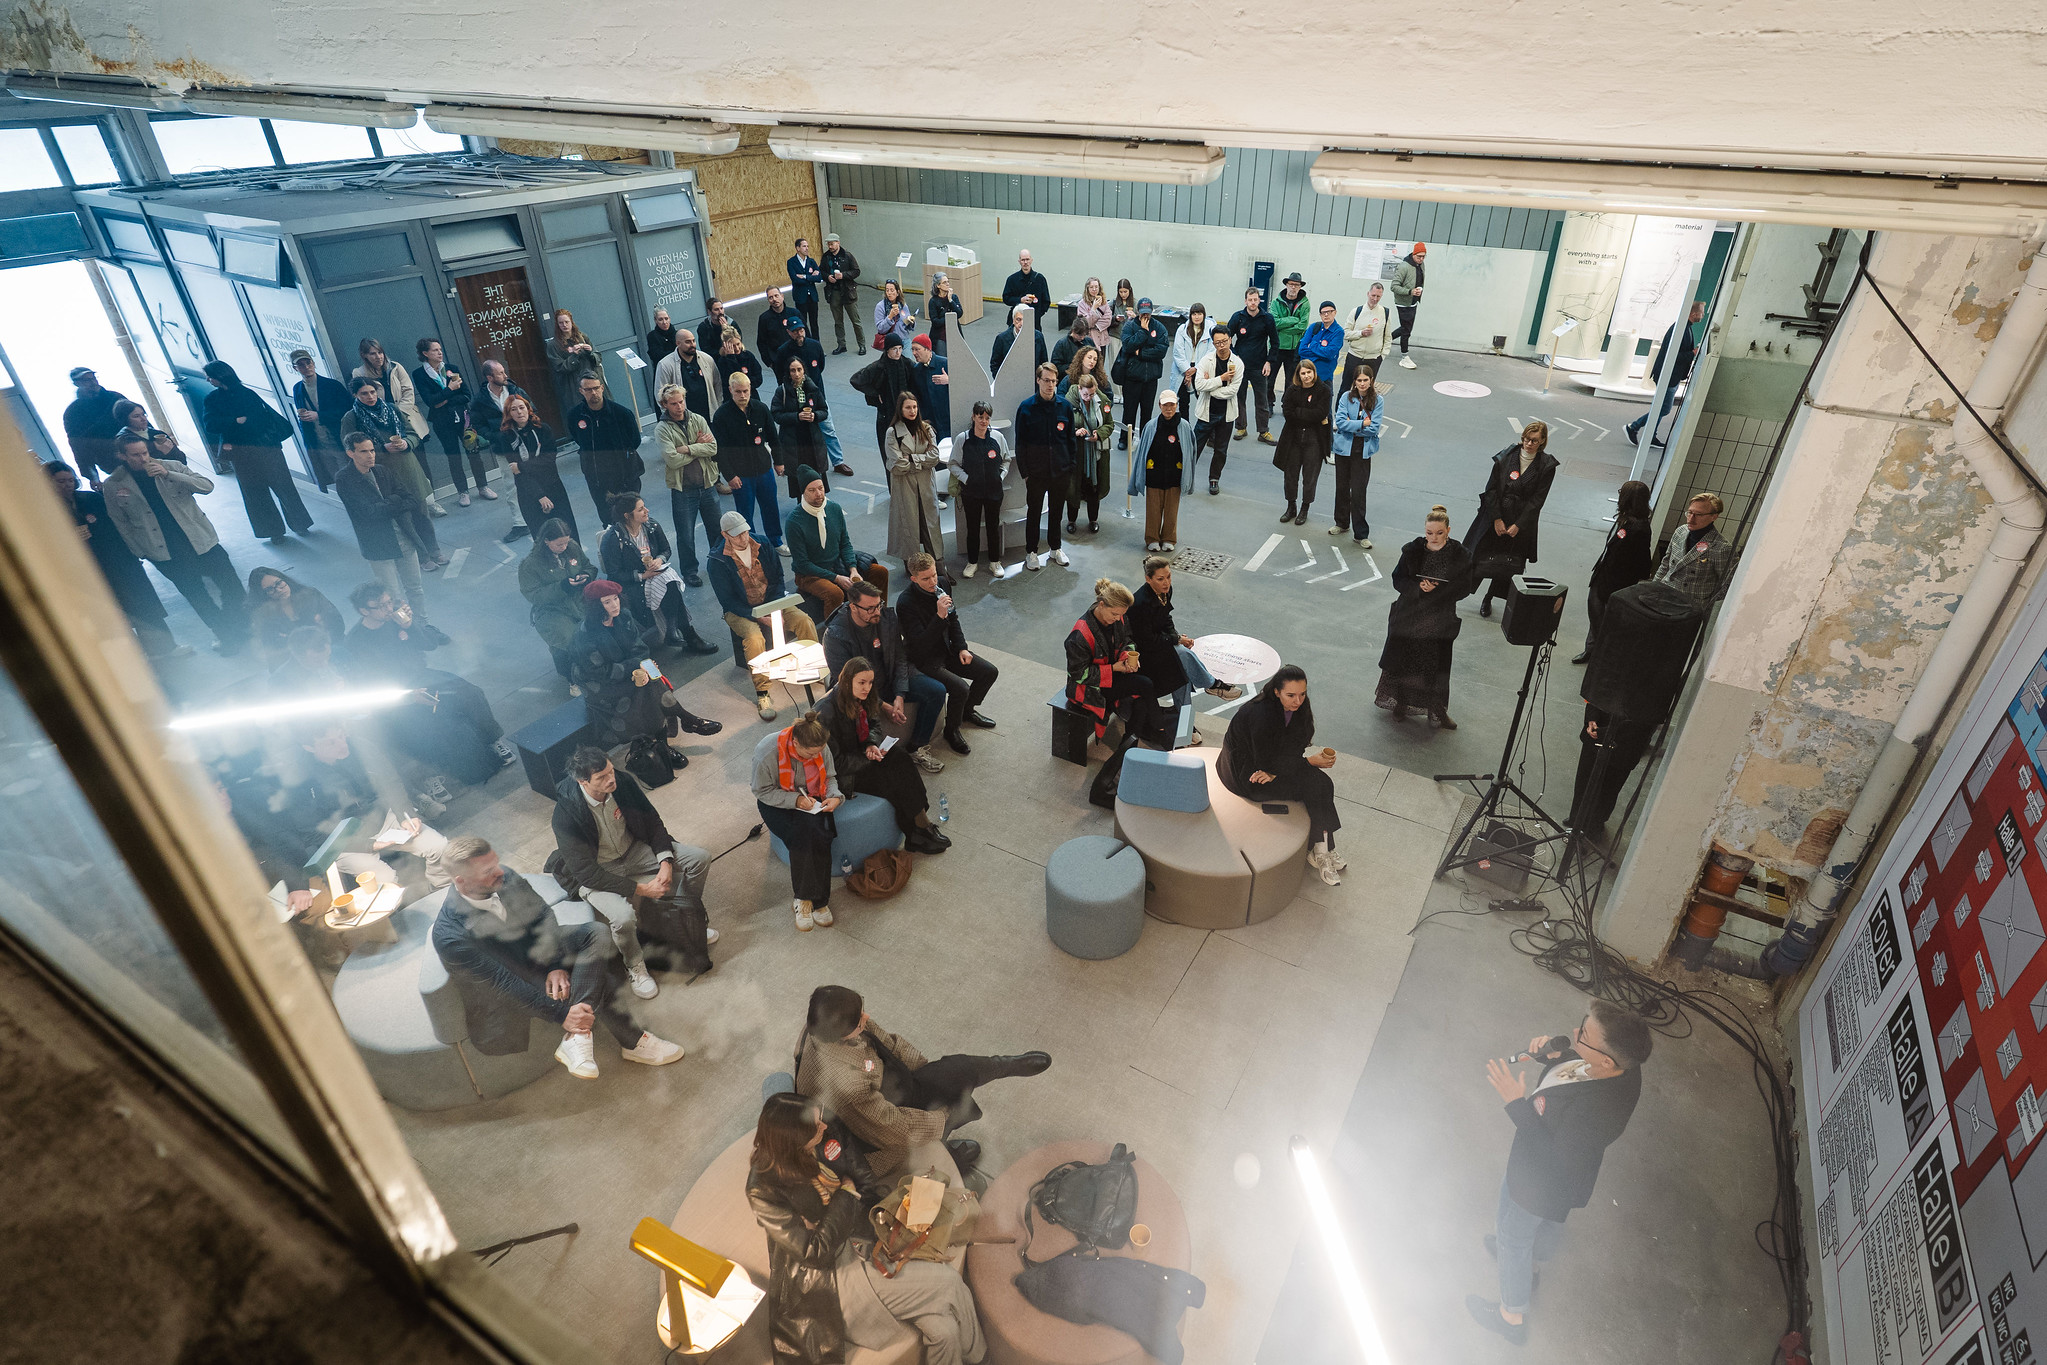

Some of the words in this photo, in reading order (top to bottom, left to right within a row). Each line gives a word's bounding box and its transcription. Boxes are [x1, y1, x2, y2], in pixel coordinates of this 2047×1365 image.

[647, 254, 672, 267] WHEN
[672, 250, 688, 262] HAS
[648, 270, 694, 288] CONNECTED
[656, 262, 683, 275] SOUND
[654, 285, 671, 296] YOU
[671, 280, 693, 292] WITH
[658, 291, 692, 306] OTHERS?
[263, 314, 286, 328] WHEN
[286, 318, 304, 332] HAS
[275, 328, 302, 342] SOUND
[1998, 814, 2015, 852] Halle
[2009, 847, 2022, 869] A
[1871, 896, 1894, 980] Foyer
[1859, 950, 1869, 1002] Immobilien
[1868, 952, 1878, 1000] Concepts
[1891, 1005, 1919, 1100] Halle
[1906, 1100, 1928, 1142] A
[1891, 1198, 1901, 1242] Sobek
[1907, 1179, 1919, 1232] AQForm
[1875, 1220, 1888, 1288] Universität
[1898, 1240, 1903, 1253] &
[1917, 1147, 1951, 1267] Halle
[1938, 1265, 1964, 1314] B
[1864, 1234, 1873, 1283] Institute
[1887, 1235, 1895, 1272] Form
[1892, 1271, 1903, 1326] Follows
[1899, 1187, 1918, 1284] BIOFABRIQUE
[1915, 1284, 1927, 1344] VIENNA
[1899, 1254, 1911, 1307] Schnurl
[1869, 1229, 1883, 1307] angewandte
[1880, 1308, 1888, 1348] Kunst
[1870, 1284, 1876, 1295] of
[1991, 1291, 2001, 1313] WC
[2004, 1277, 2014, 1300] WC
[1872, 1300, 1884, 1365] Architectu
[1997, 1318, 2007, 1341] WC
